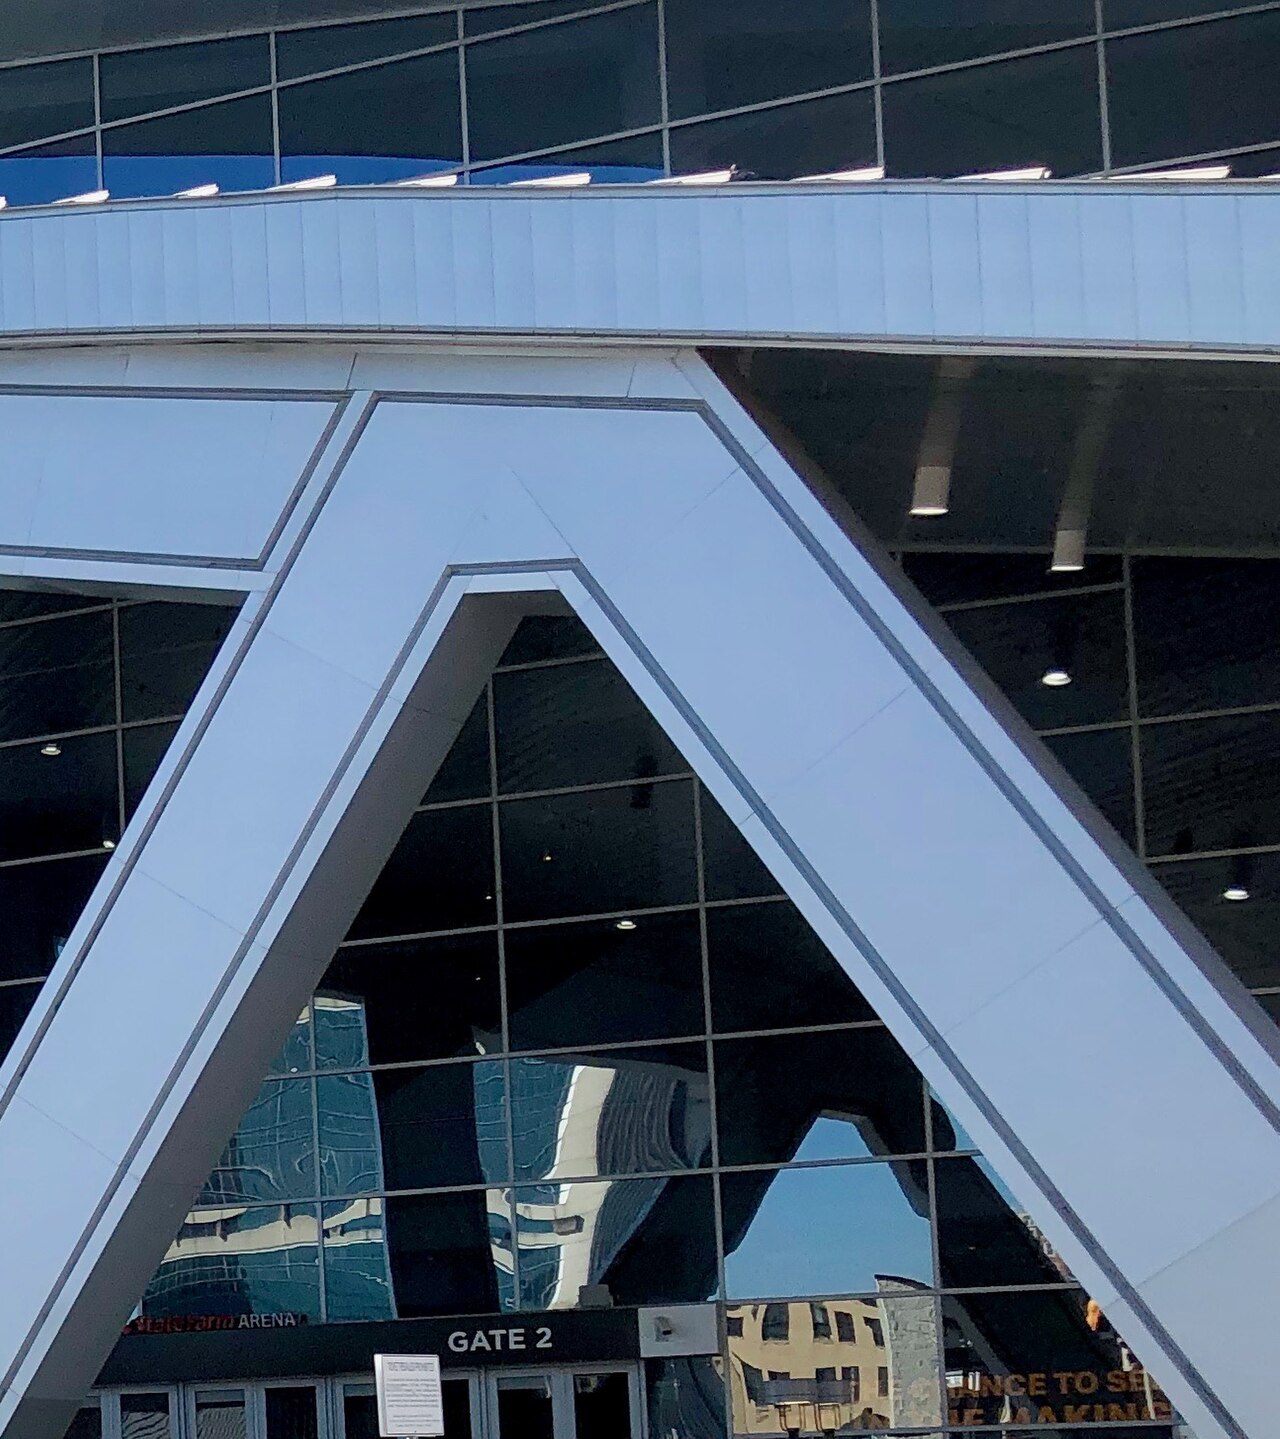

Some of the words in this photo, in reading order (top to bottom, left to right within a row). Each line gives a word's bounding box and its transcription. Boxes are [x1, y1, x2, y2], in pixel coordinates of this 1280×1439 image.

[238, 1313, 296, 1328] ARENA
[447, 1328, 526, 1353] GATE
[536, 1327, 553, 1348] 2
[1052, 1371, 1100, 1394] TO
